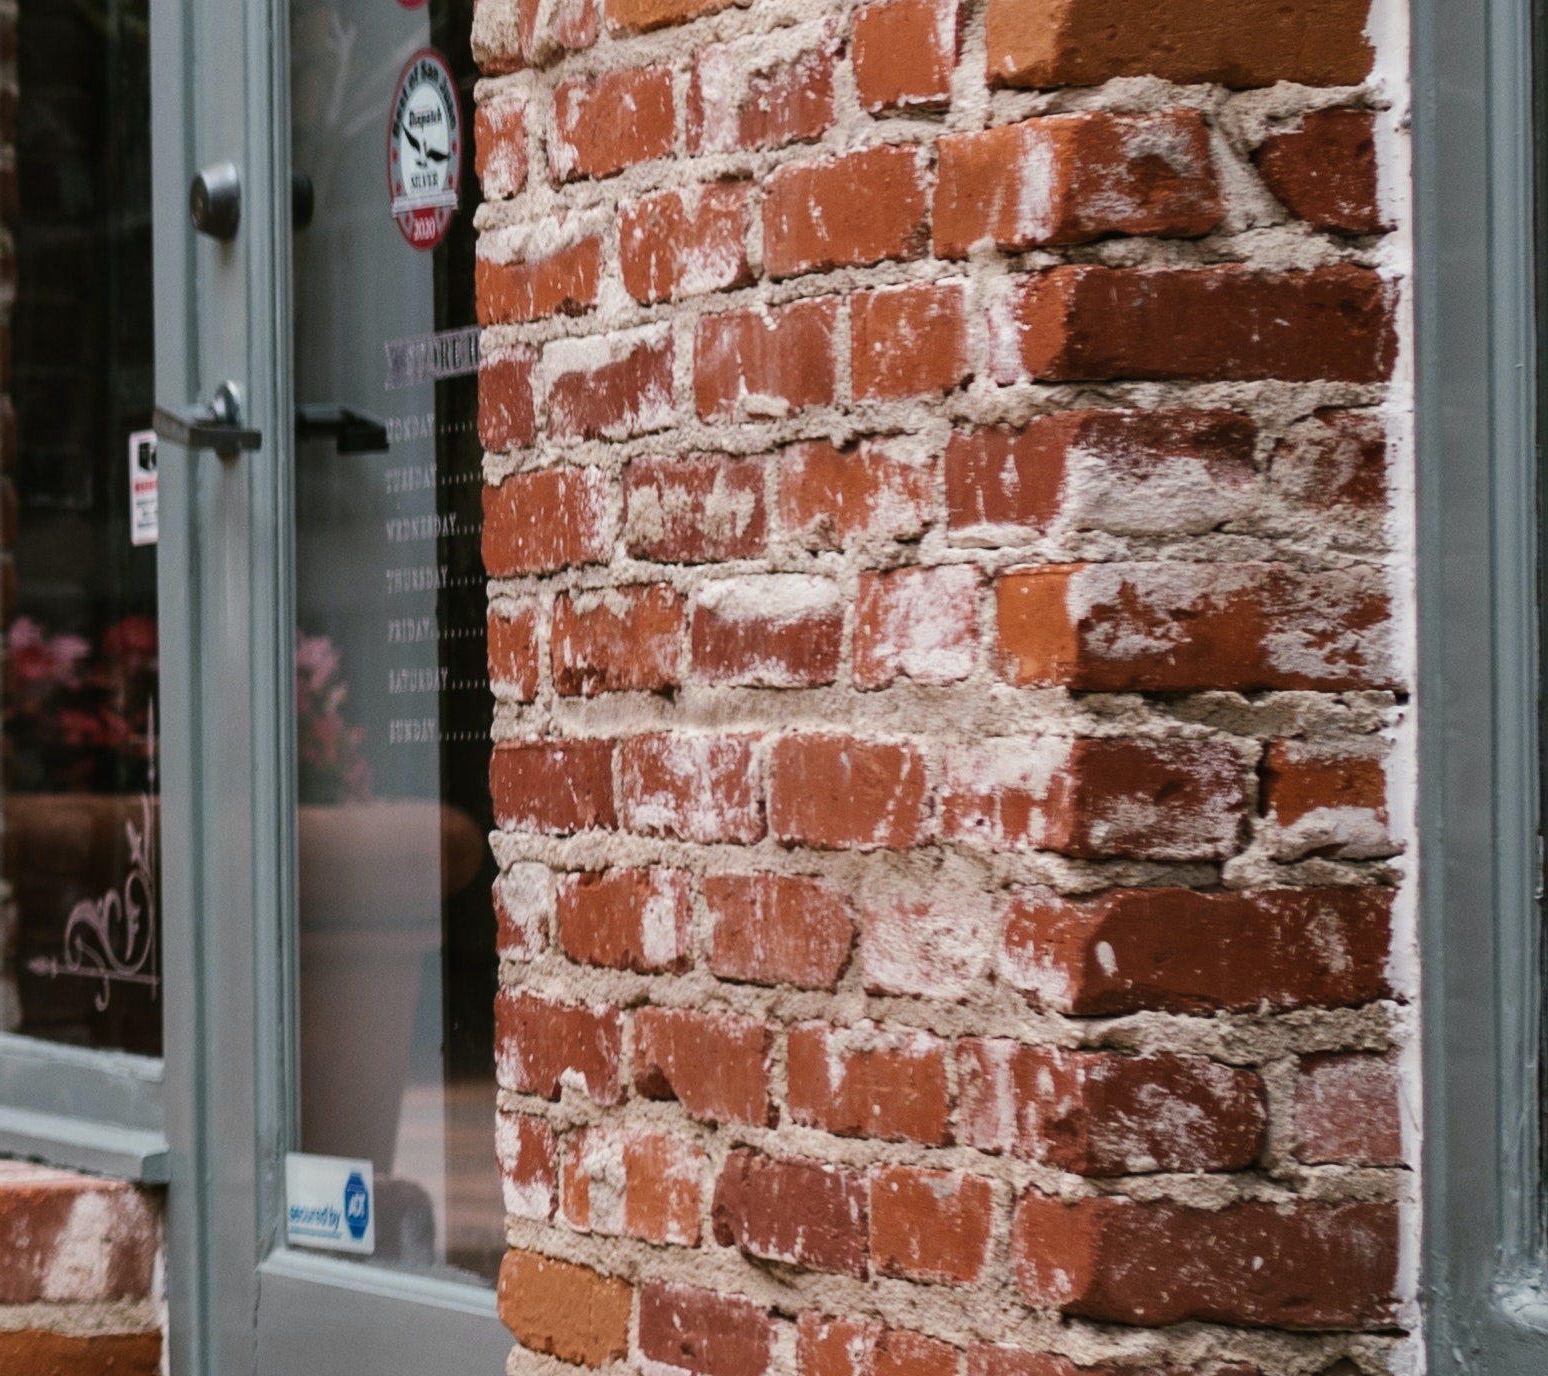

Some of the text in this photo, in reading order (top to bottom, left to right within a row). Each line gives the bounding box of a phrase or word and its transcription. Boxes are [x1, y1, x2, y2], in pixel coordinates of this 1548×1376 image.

[413, 218, 436, 241] 2020
[290, 1192, 366, 1233] secured by ADT
